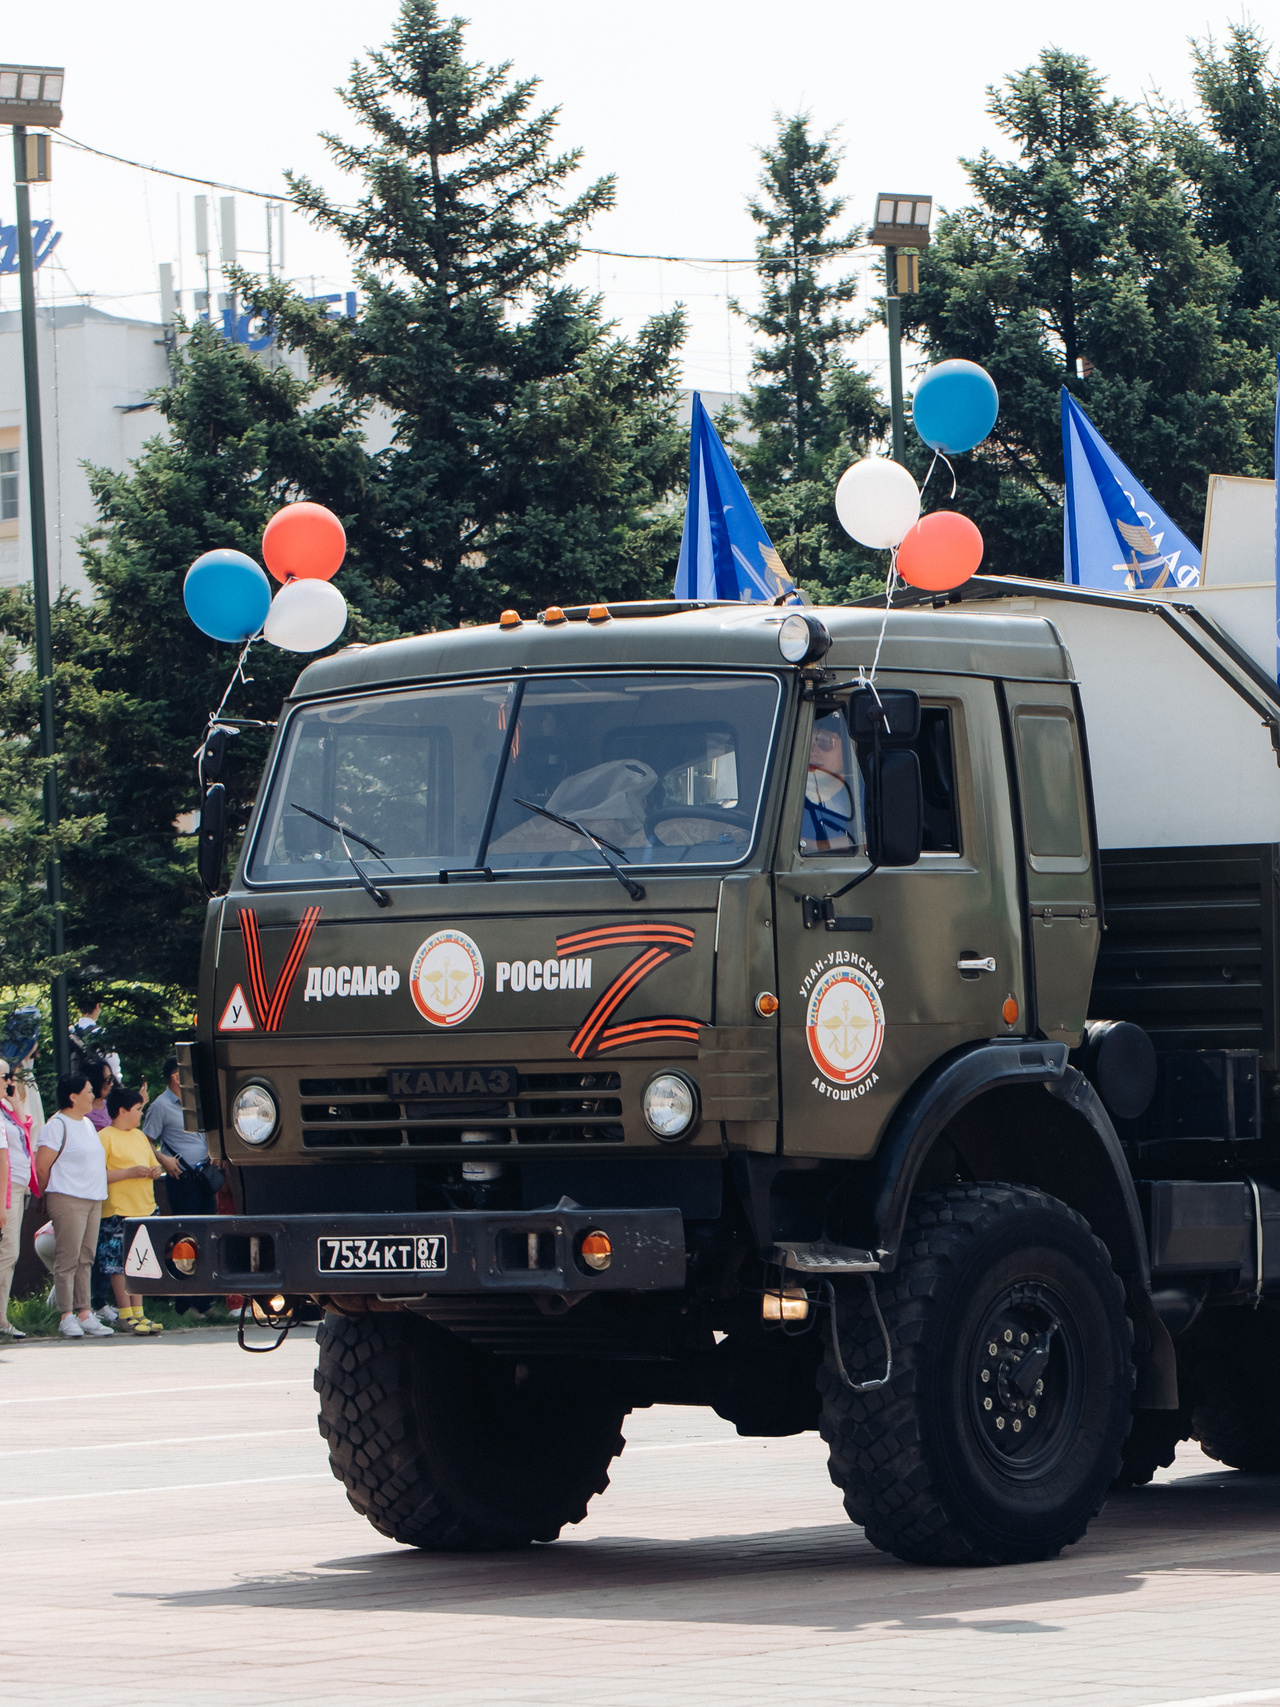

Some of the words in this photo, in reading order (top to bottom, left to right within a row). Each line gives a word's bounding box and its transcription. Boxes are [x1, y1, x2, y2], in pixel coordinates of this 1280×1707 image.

[304, 965, 401, 1002] ДОСААФ
[495, 957, 593, 993] РОССИИ
[799, 950, 885, 998] УЛАН-УДЭНСКАЯ
[391, 1070, 510, 1094] КАМАЗ
[811, 1072, 880, 1101] АВТОШКОЛА
[417, 1238, 440, 1260] 87
[420, 1260, 437, 1268] RUS
